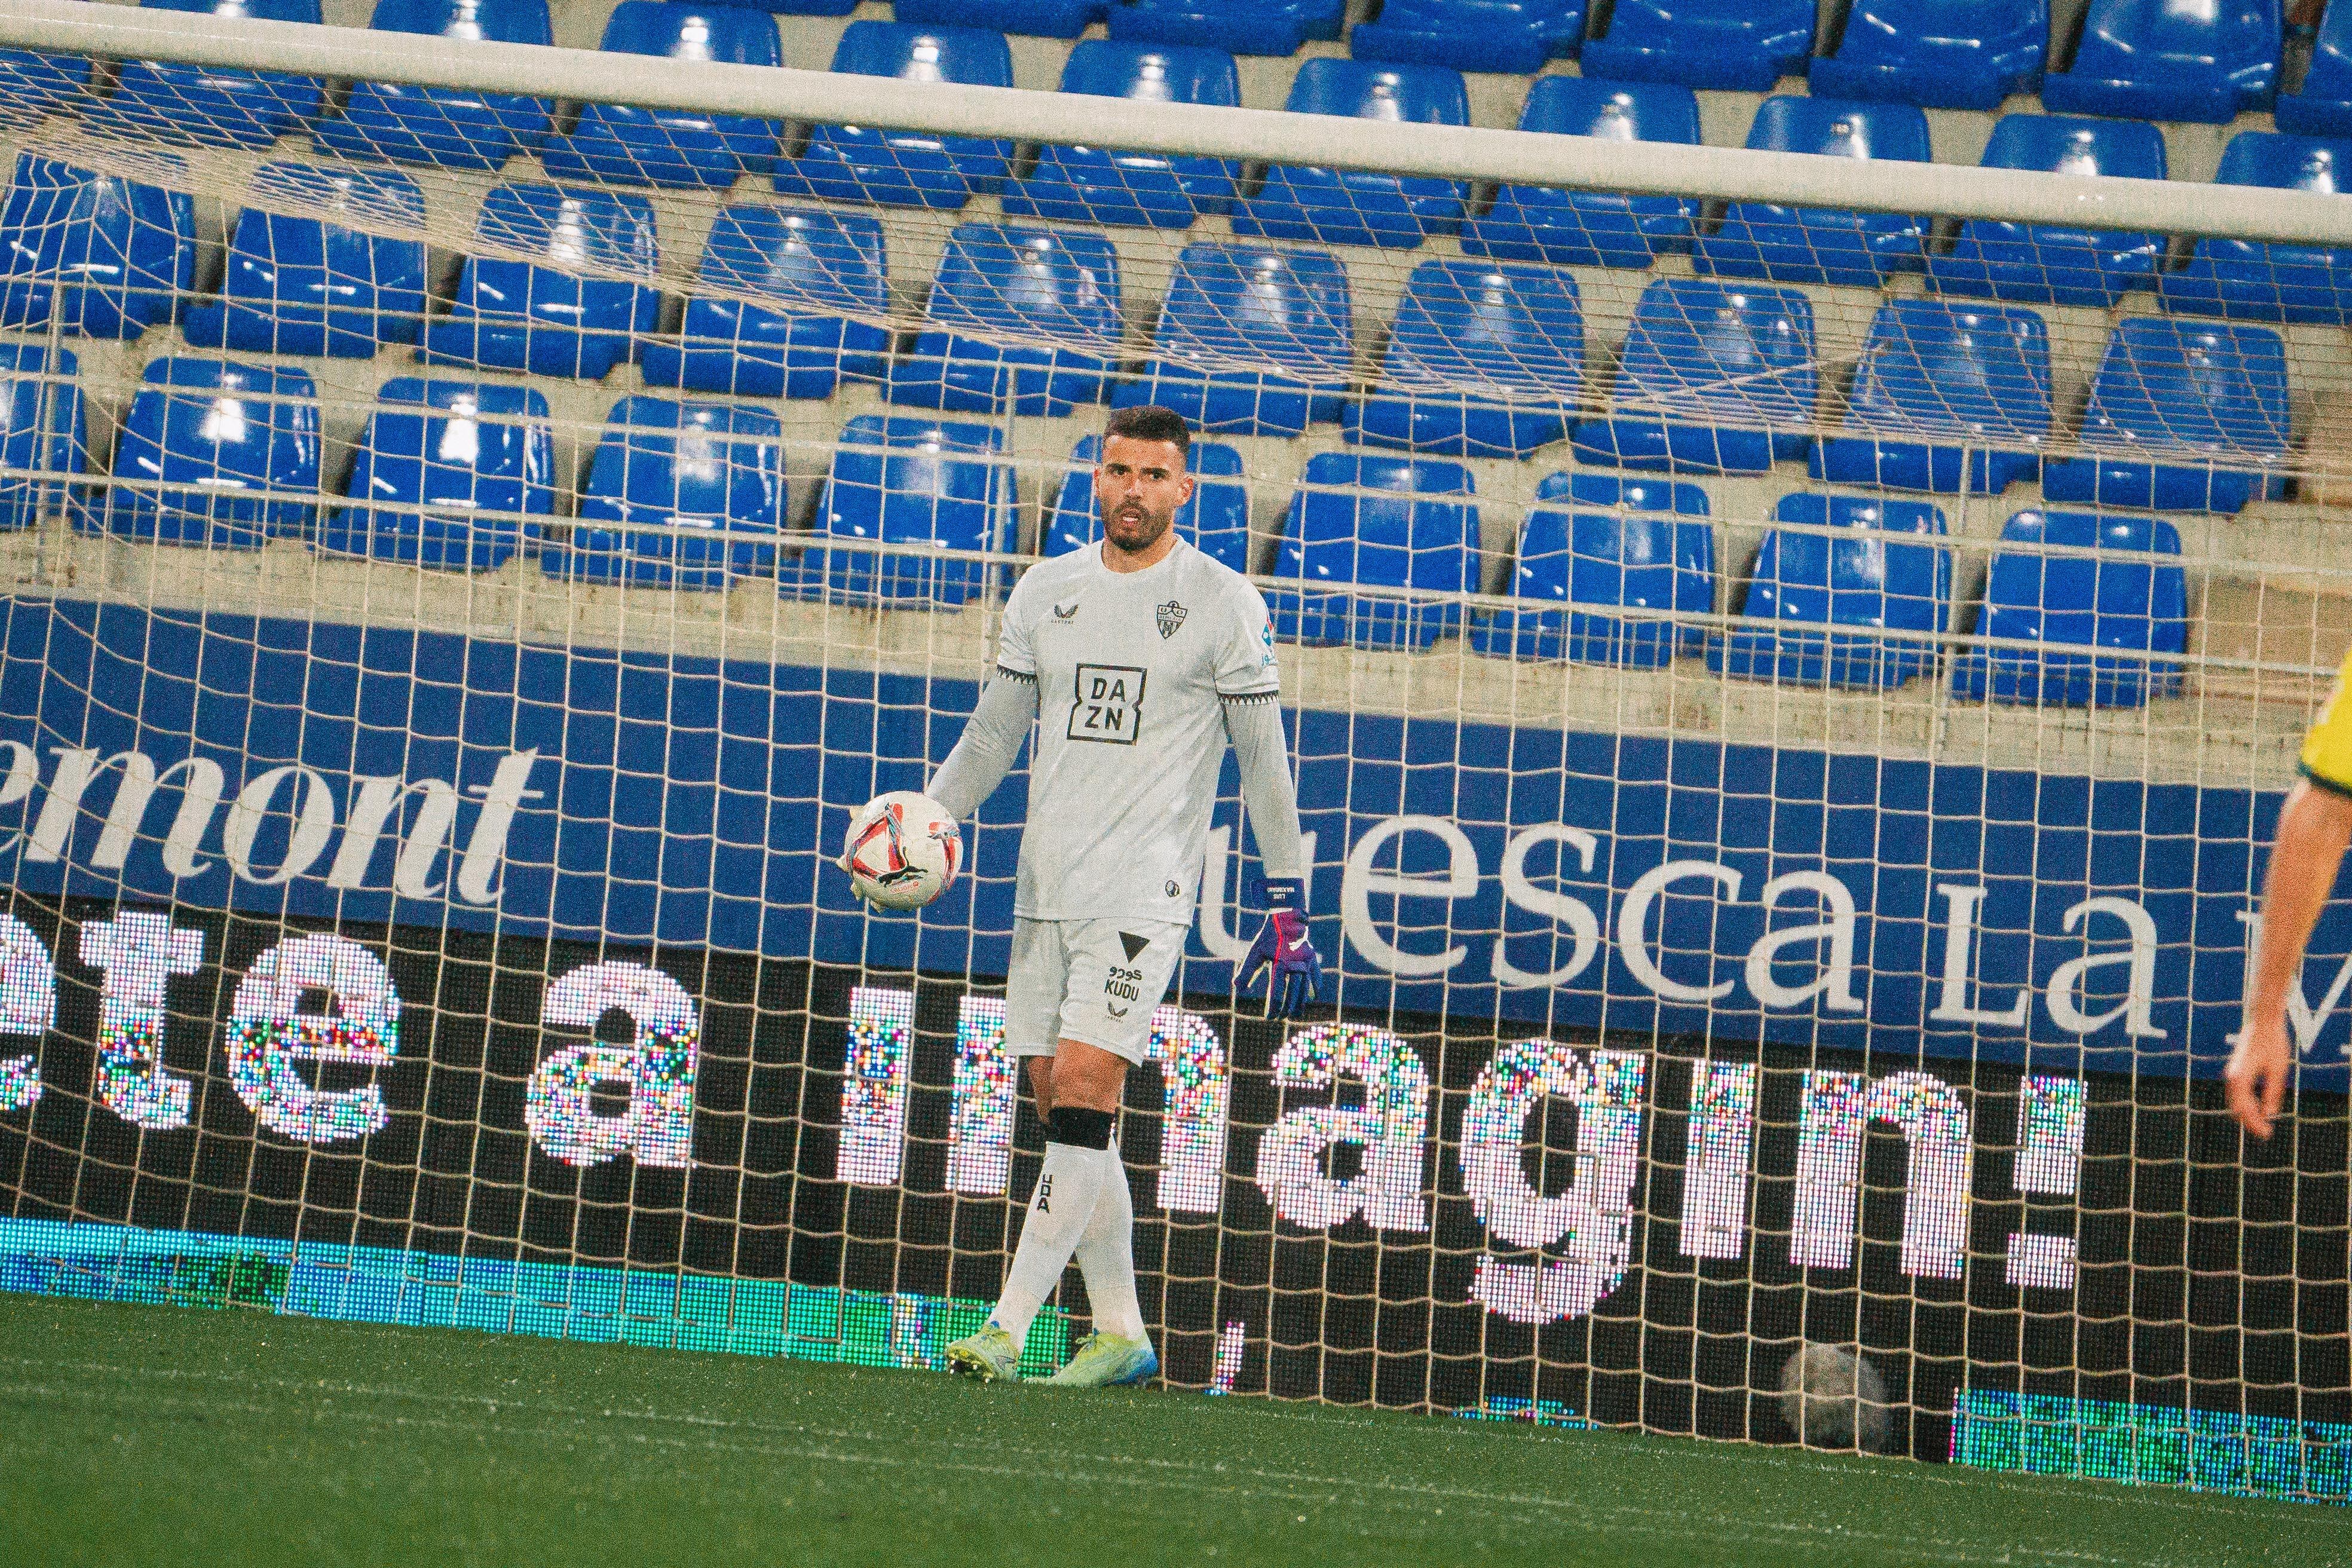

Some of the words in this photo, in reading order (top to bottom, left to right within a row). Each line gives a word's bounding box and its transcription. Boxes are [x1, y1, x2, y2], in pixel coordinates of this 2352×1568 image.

[1104, 979, 1140, 1002] KUDU
[1200, 814, 1864, 1011] uesca
[1930, 883, 2167, 1039] La
[525, 960, 699, 1169] a
